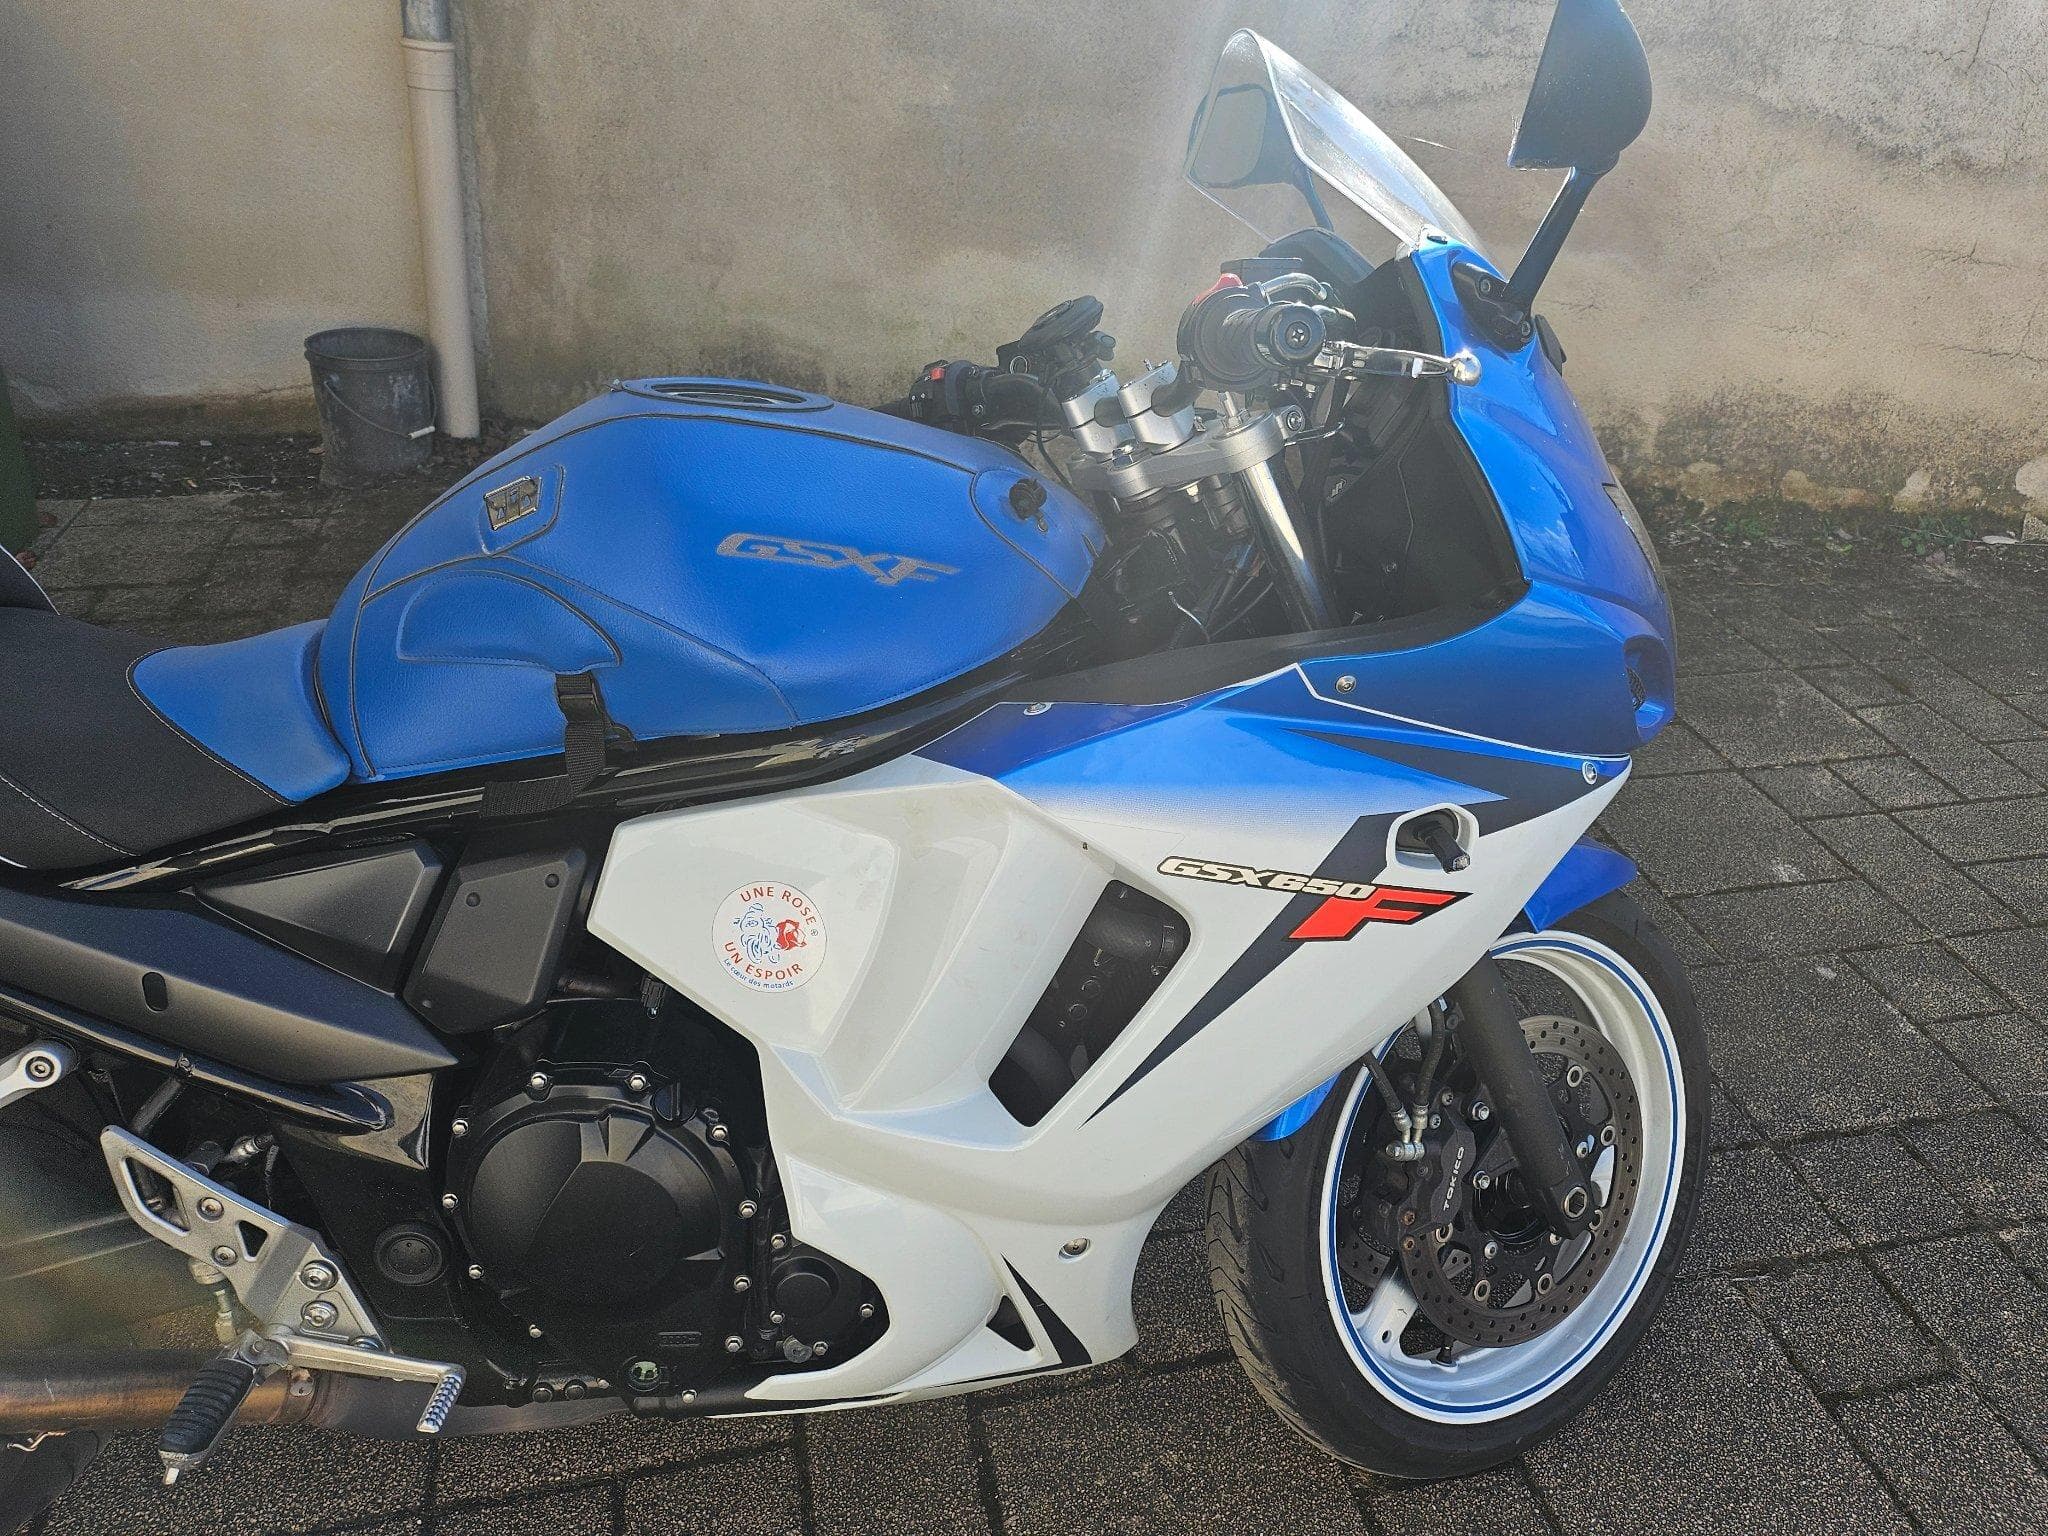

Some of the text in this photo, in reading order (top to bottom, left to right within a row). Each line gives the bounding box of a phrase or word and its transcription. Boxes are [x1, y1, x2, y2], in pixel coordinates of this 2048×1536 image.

[740, 886, 817, 925] UNE ROSE
[724, 941, 803, 980] UN ESPOIR
[748, 977, 761, 987] des
[763, 980, 794, 989] motards
[1443, 1147, 1465, 1211] TOKICO
